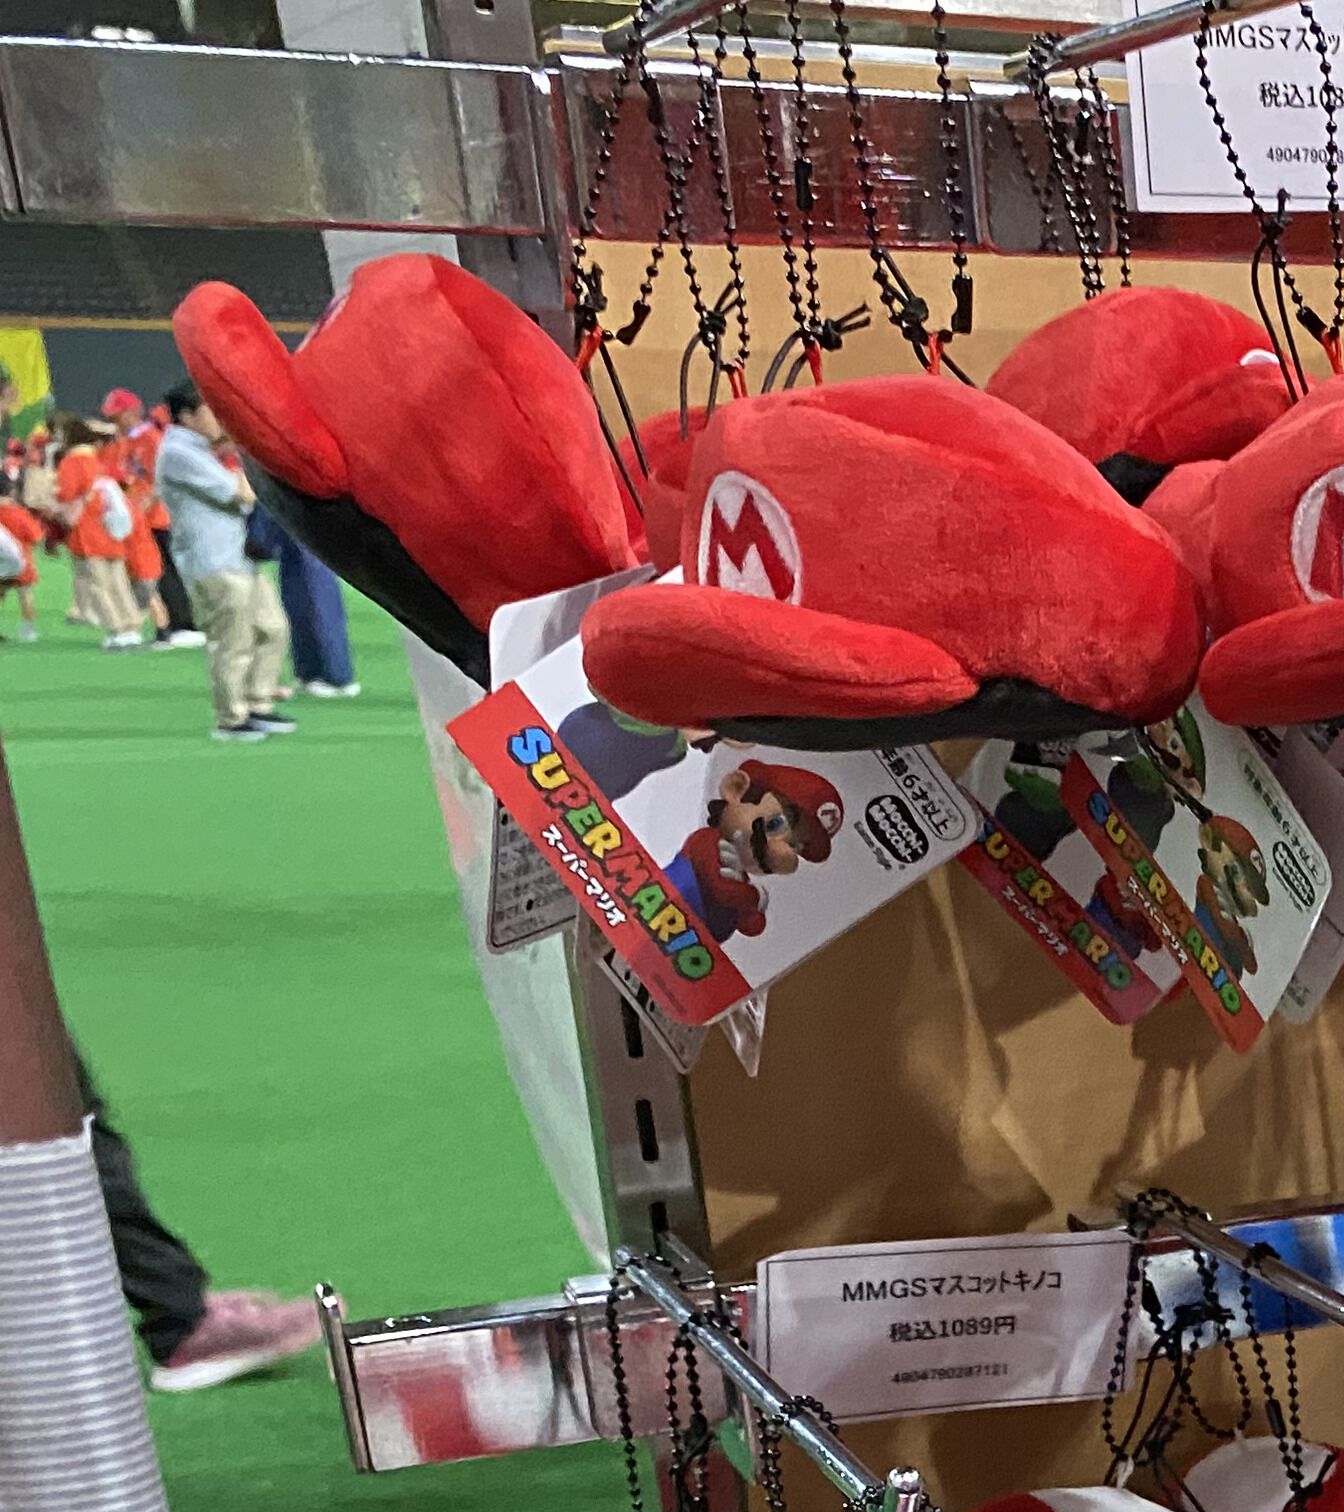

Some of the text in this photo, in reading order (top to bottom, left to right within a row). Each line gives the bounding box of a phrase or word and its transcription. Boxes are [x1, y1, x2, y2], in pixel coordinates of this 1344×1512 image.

[507, 726, 625, 862] SUPER
[602, 850, 716, 981] MARIO
[540, 823, 628, 928] スーパーマリオ
[842, 1270, 1062, 1303] MMGSマスコットキノコ
[889, 1316, 1015, 1343] 税込1089円
